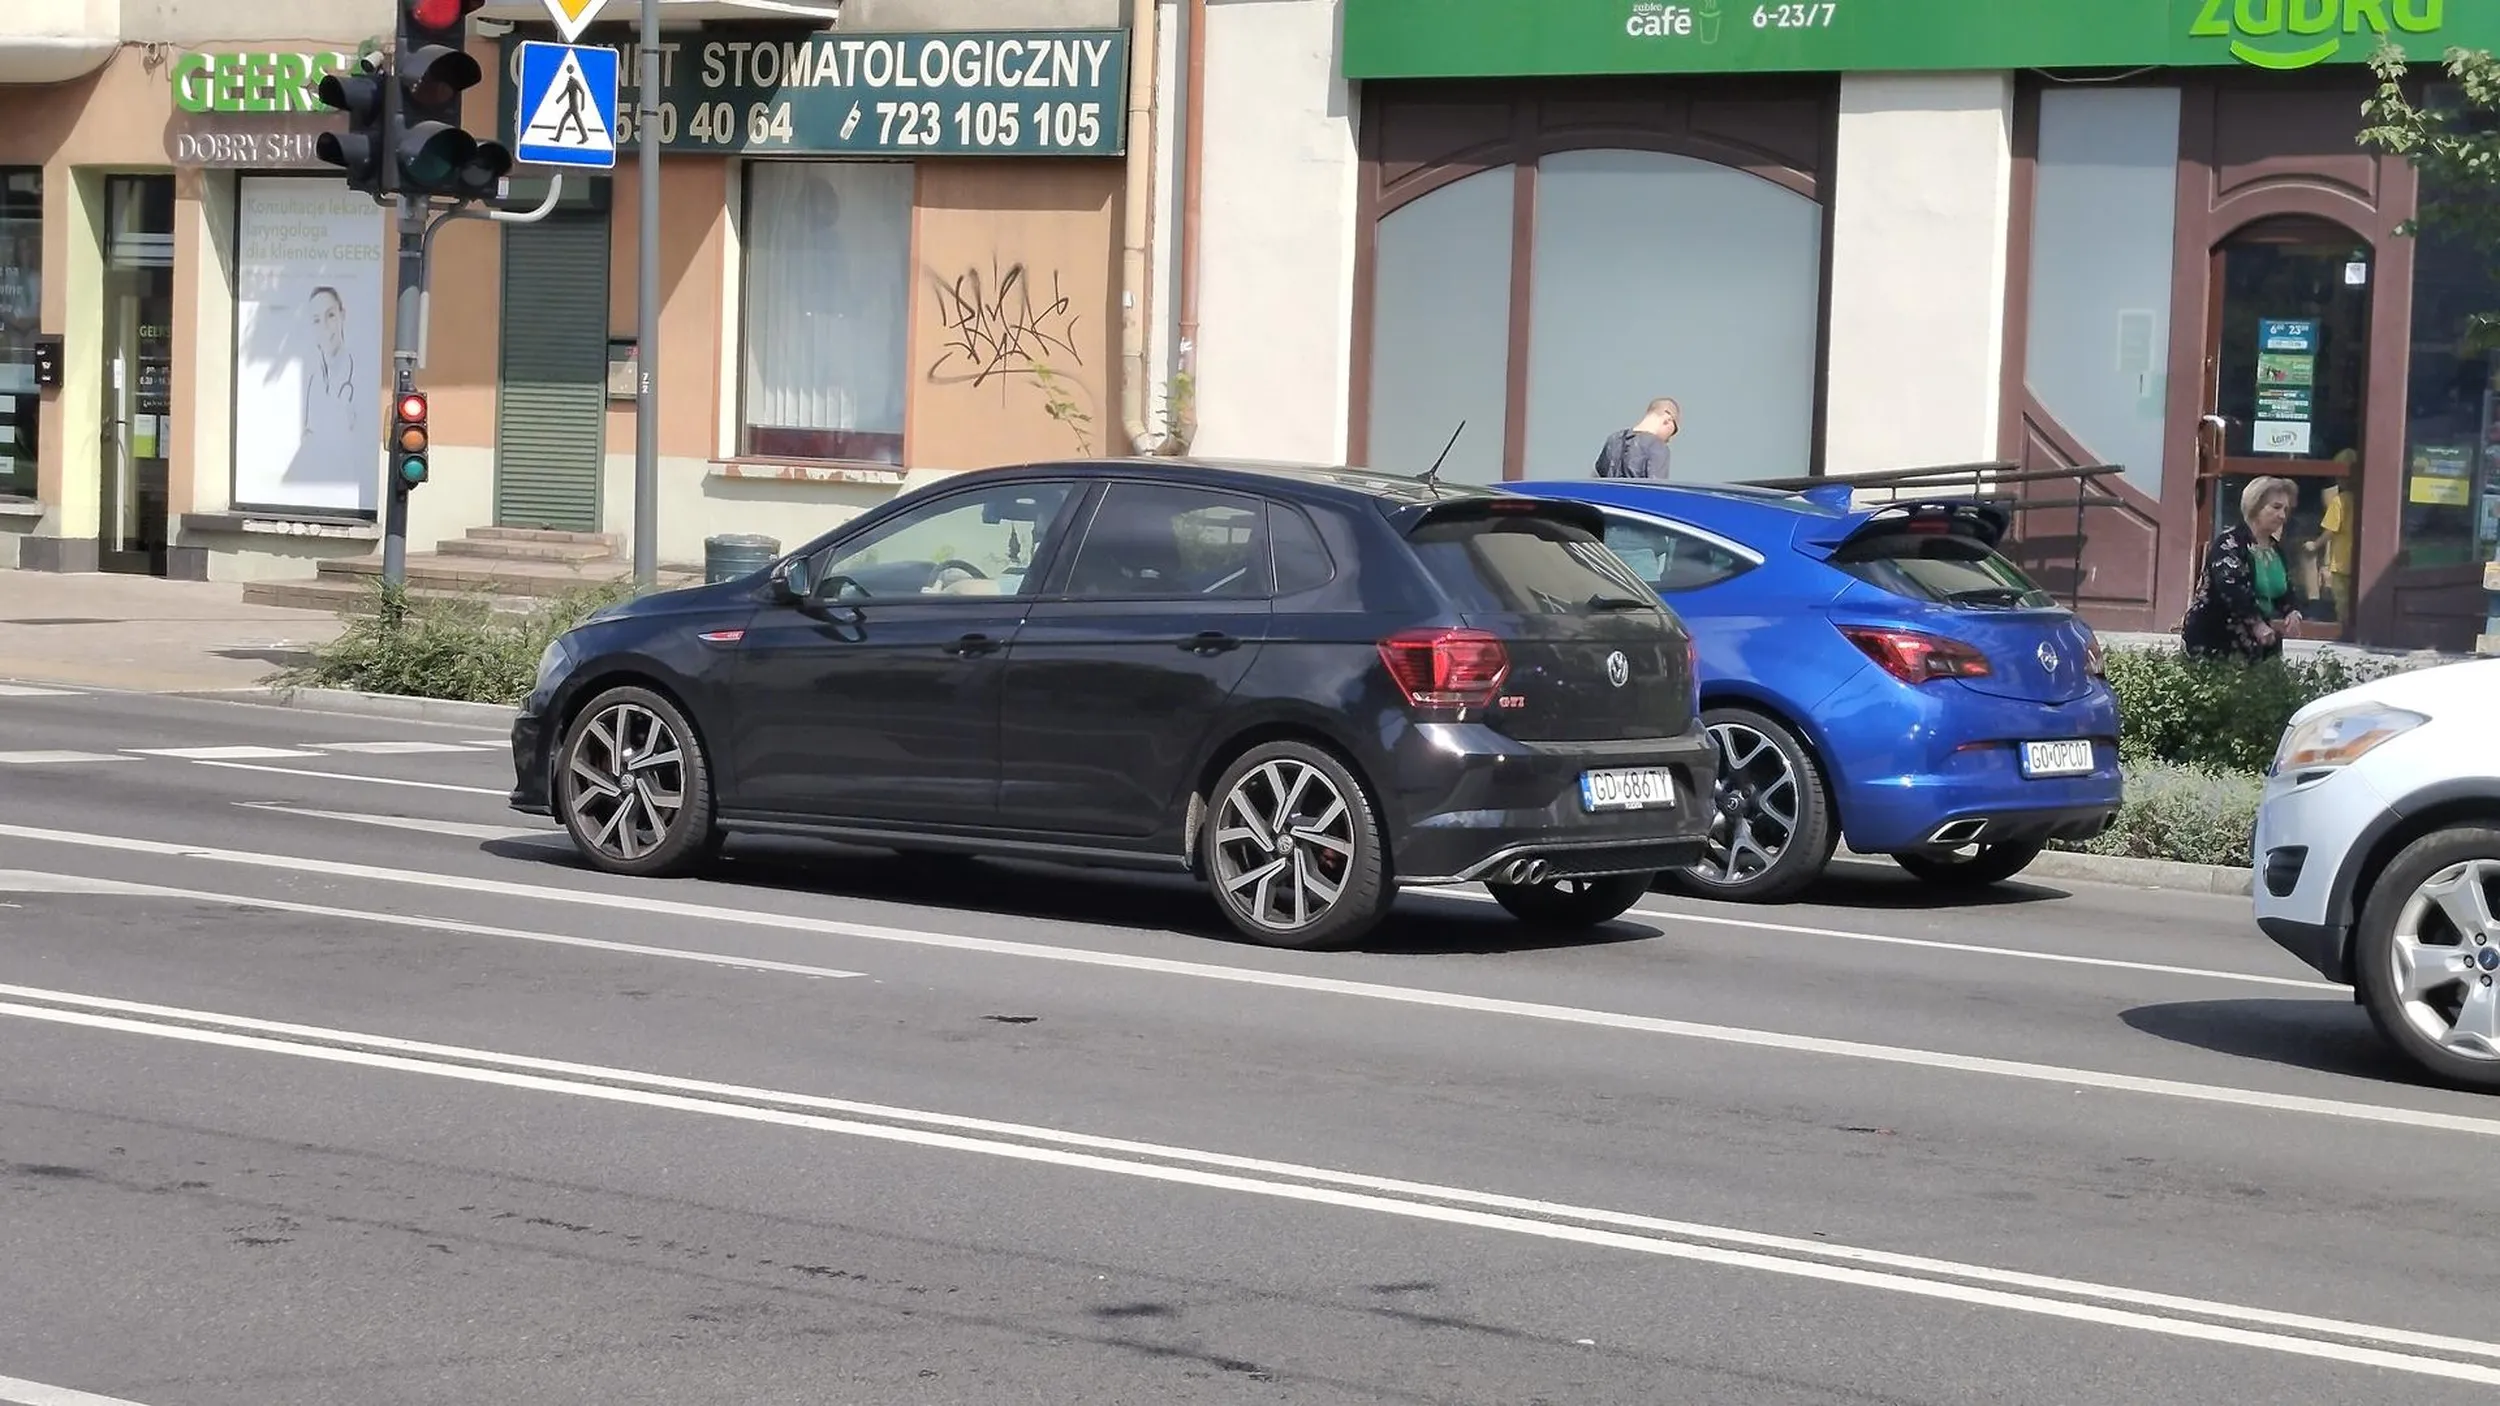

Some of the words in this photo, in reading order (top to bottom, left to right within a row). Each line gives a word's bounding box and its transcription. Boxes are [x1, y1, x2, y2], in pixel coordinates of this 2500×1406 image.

[1752, 3, 1836, 28] 6-23/7
[702, 39, 1111, 88] STOMATOLOGICZNY
[172, 52, 346, 113] GEERS
[689, 102, 735, 144] 40
[747, 102, 793, 145] 64
[876, 102, 942, 145] 723
[954, 101, 1020, 146] 105
[1033, 102, 1101, 147] 105
[178, 132, 261, 162] DOBRY
[248, 198, 326, 218] Konsultacje
[329, 198, 380, 215] lekarza
[246, 220, 329, 241] laryngologa
[246, 241, 267, 259] dla
[270, 241, 329, 260] klientów
[333, 245, 381, 260] GEERS
[1499, 696, 1525, 708] GTI
[1594, 771, 1617, 801] GD
